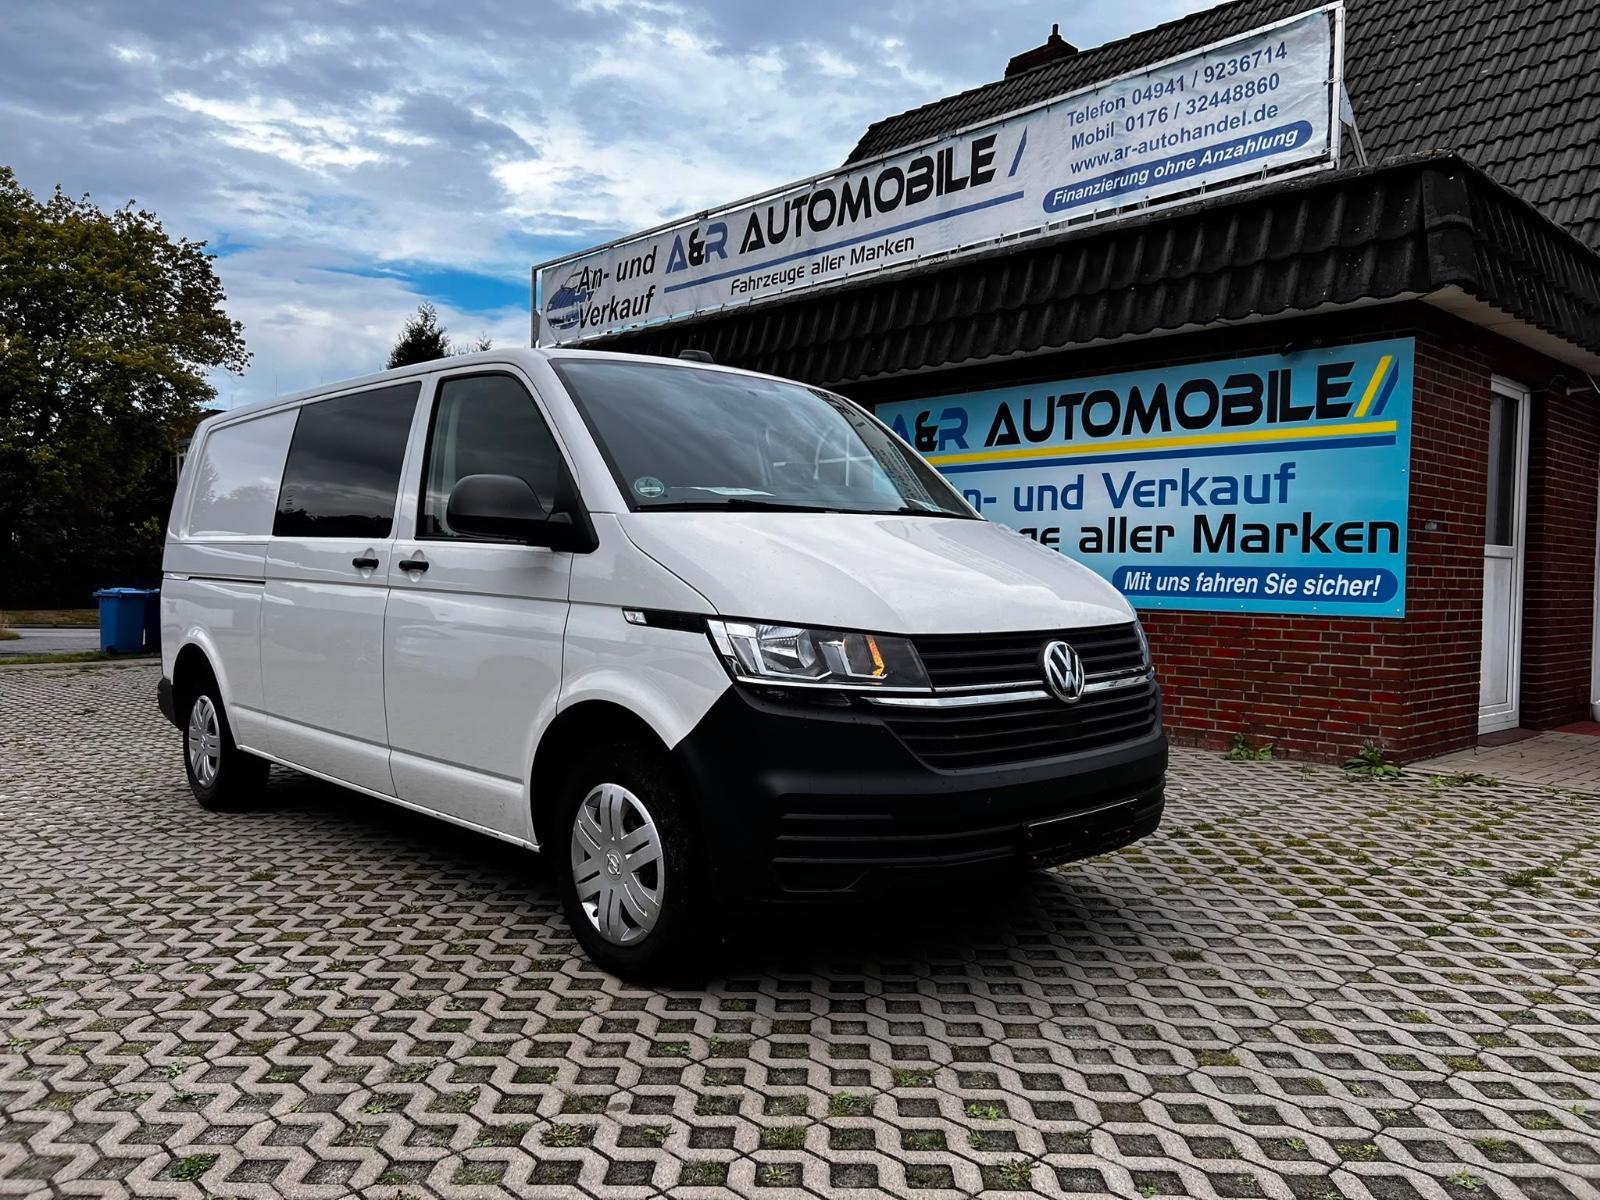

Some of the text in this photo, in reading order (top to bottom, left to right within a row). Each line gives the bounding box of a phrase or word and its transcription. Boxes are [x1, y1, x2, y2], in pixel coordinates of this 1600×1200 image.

[1067, 96, 1126, 127] Telefon
[1132, 79, 1185, 105] 04941
[1204, 41, 1288, 84] 9236714
[1071, 125, 1115, 150] Mobil
[1126, 107, 1168, 132] 0176
[1186, 72, 1280, 116] 32448860
[1053, 128, 1299, 206] Finanzierung ohne Anzahlung
[1070, 103, 1279, 174] www.ar-autohandel.de
[665, 134, 998, 274] A&R AUTOMOBILE
[576, 246, 657, 294] An- und
[731, 236, 914, 296] Fahrzeuge aller Marken
[579, 284, 656, 329] Verkauf
[984, 361, 1355, 448] AUTOMOBILE
[1013, 474, 1085, 512] und
[1102, 461, 1296, 509] Verkauf
[1079, 516, 1175, 554] aller
[1193, 511, 1400, 554] Marken
[1124, 571, 1382, 597] Mit uns fahren Sie sicher!
